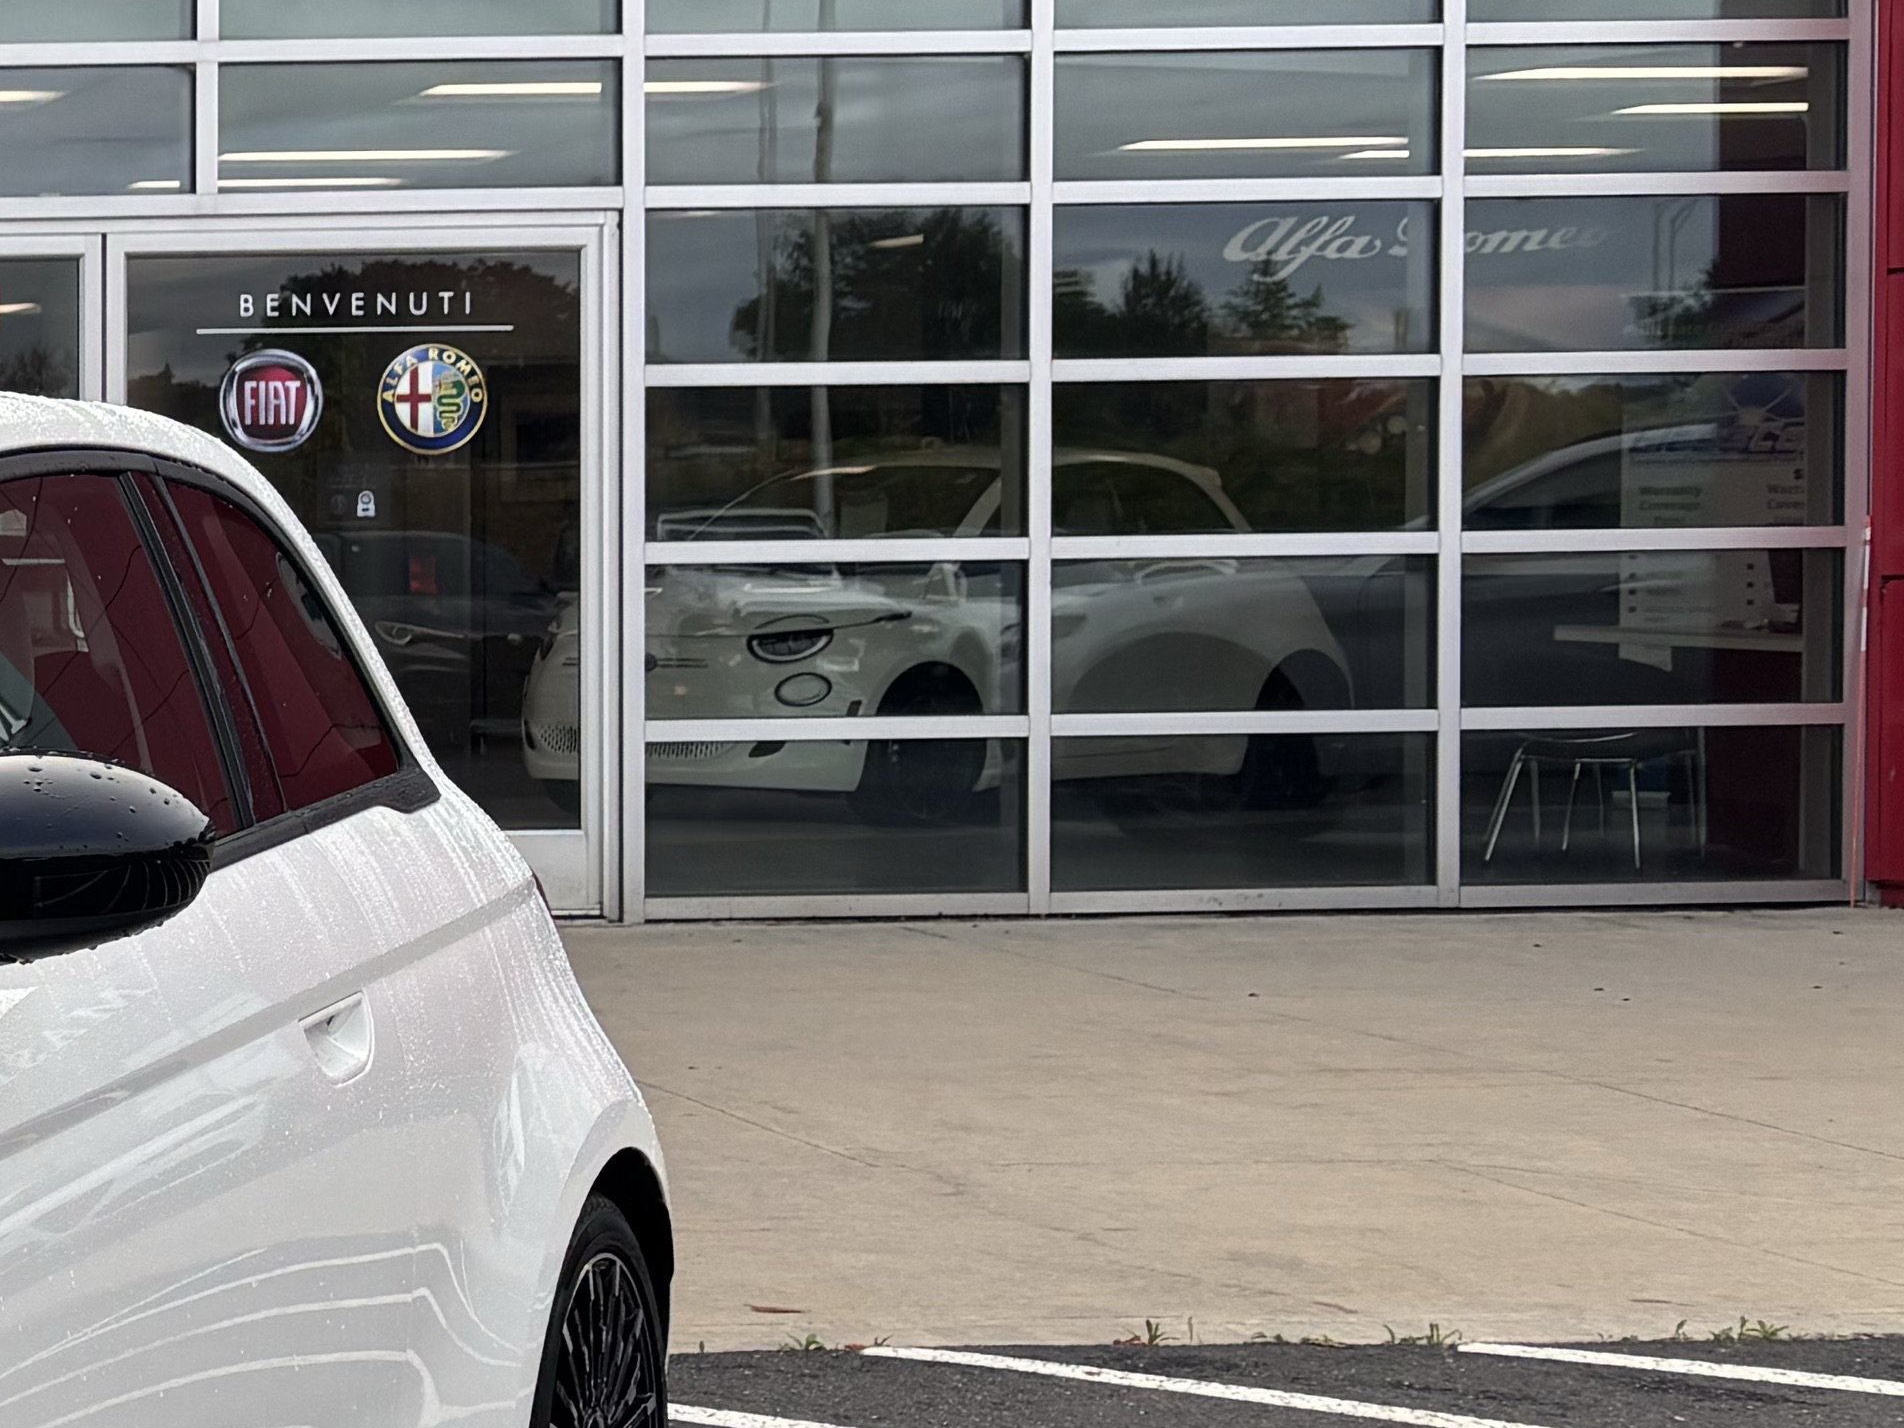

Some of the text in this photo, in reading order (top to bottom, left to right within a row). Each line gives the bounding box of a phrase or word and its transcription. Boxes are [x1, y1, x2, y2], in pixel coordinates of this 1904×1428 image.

[1221, 215, 1382, 282] Alfa
[239, 290, 473, 318] BENVENUTI
[382, 347, 484, 404] ALFA ROMEO
[243, 378, 302, 426] FIAT
